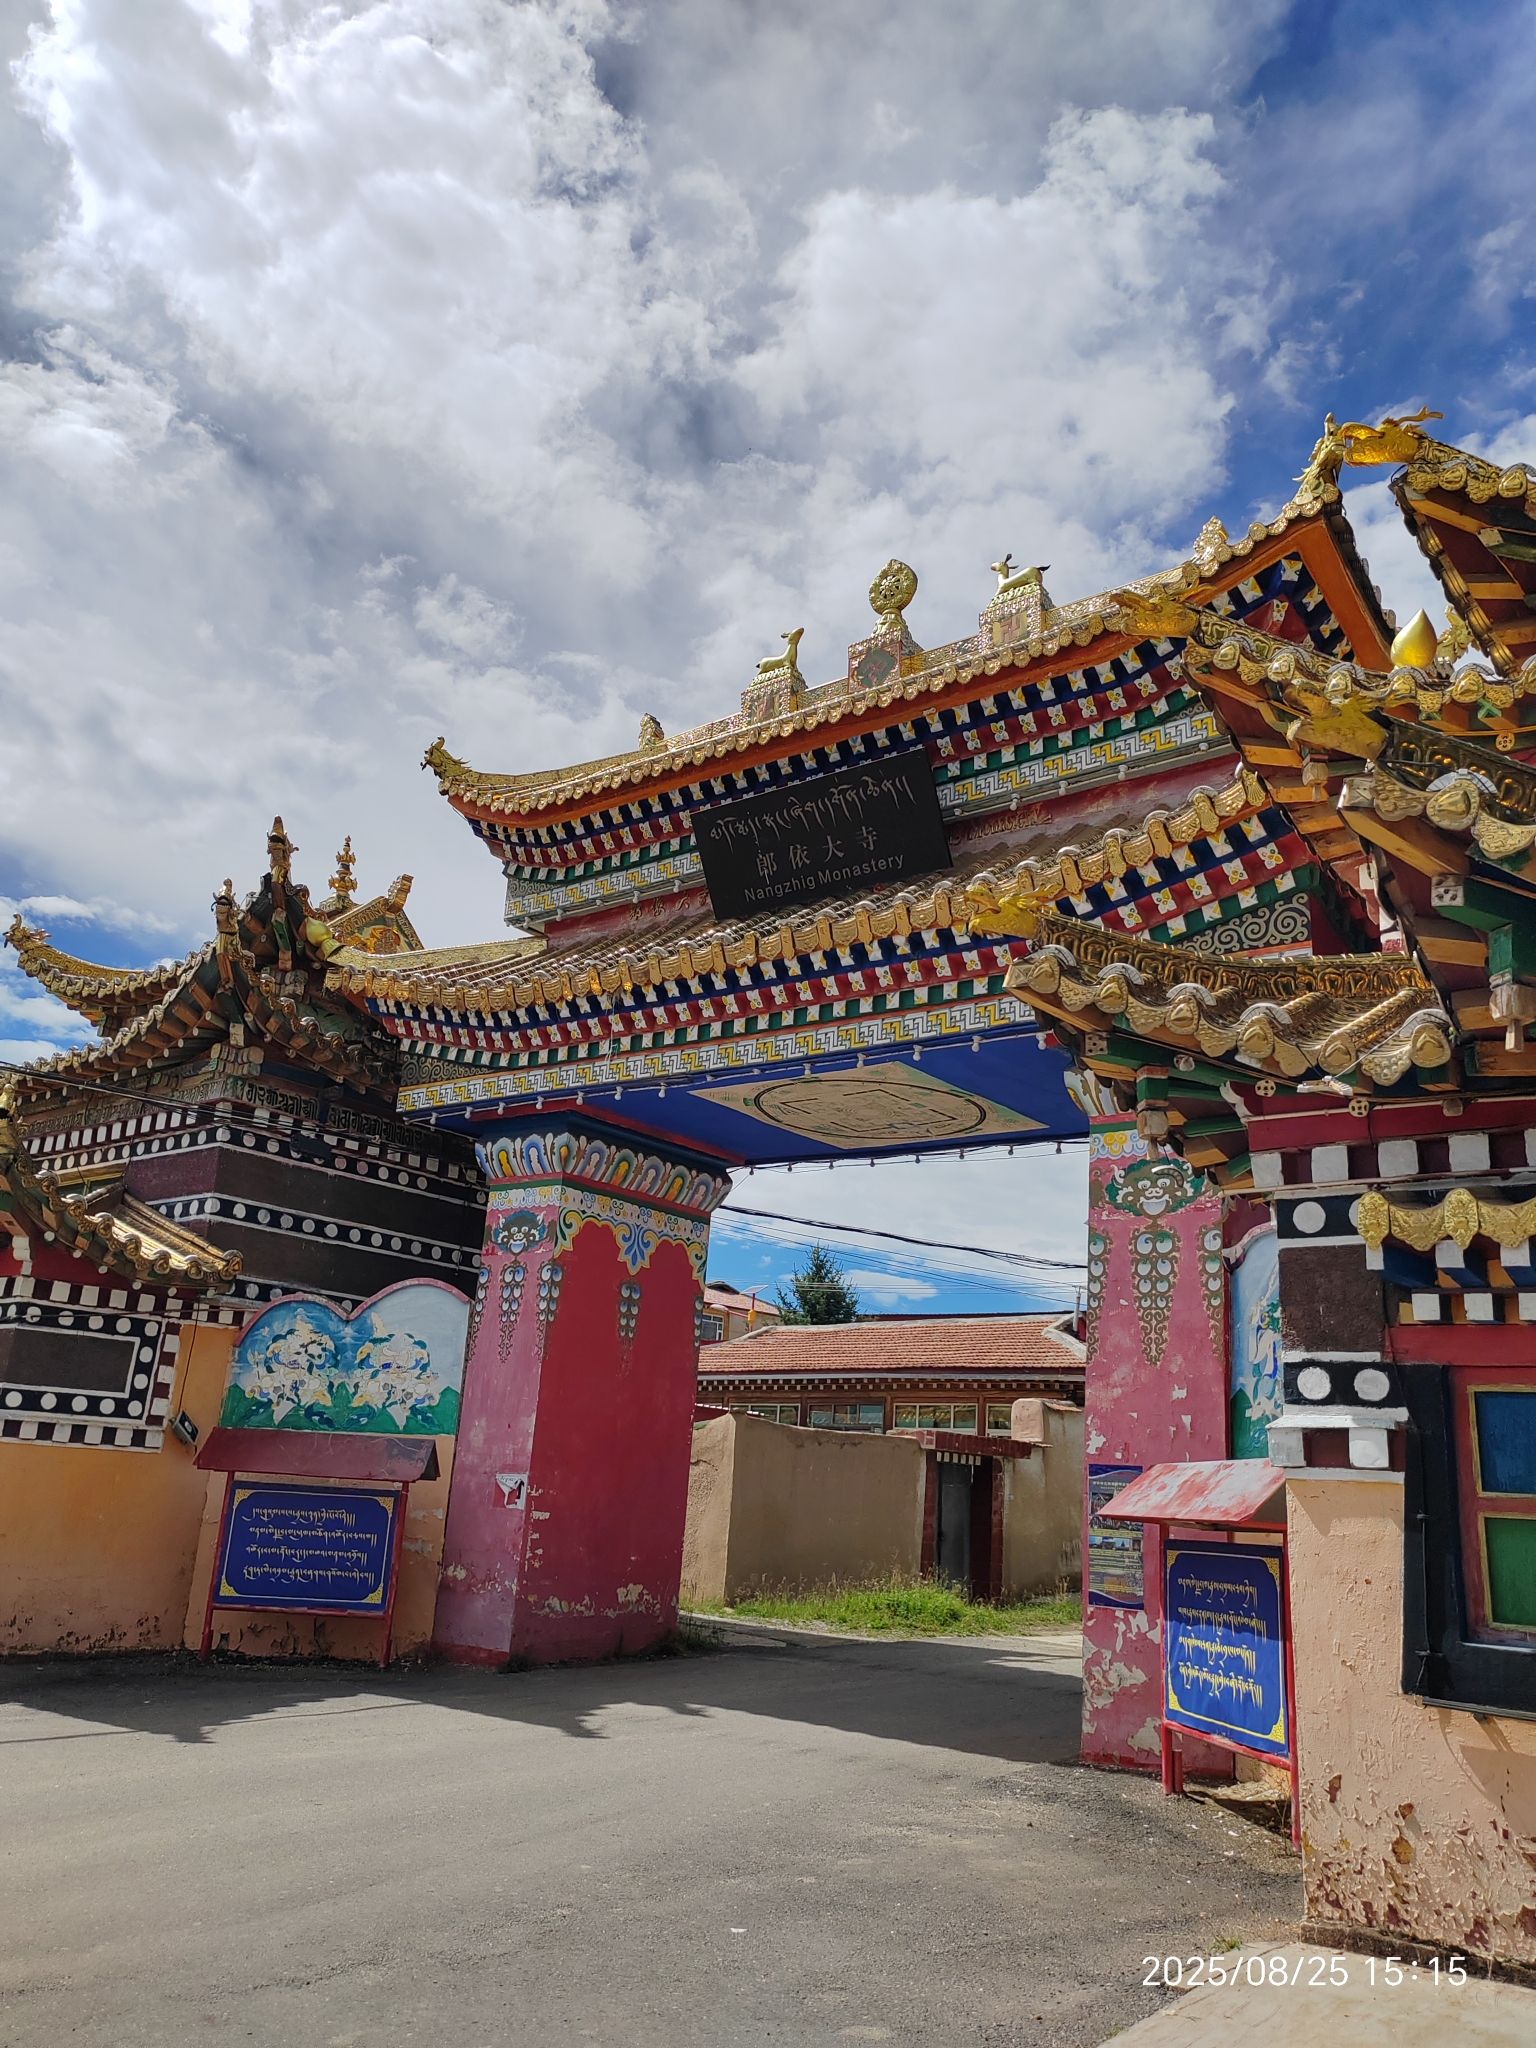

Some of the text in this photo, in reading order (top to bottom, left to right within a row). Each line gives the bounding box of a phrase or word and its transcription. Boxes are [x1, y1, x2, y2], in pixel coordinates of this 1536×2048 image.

[756, 825, 878, 878] 郎依大寺
[744, 854, 904, 903] Nangzhig Monastery
